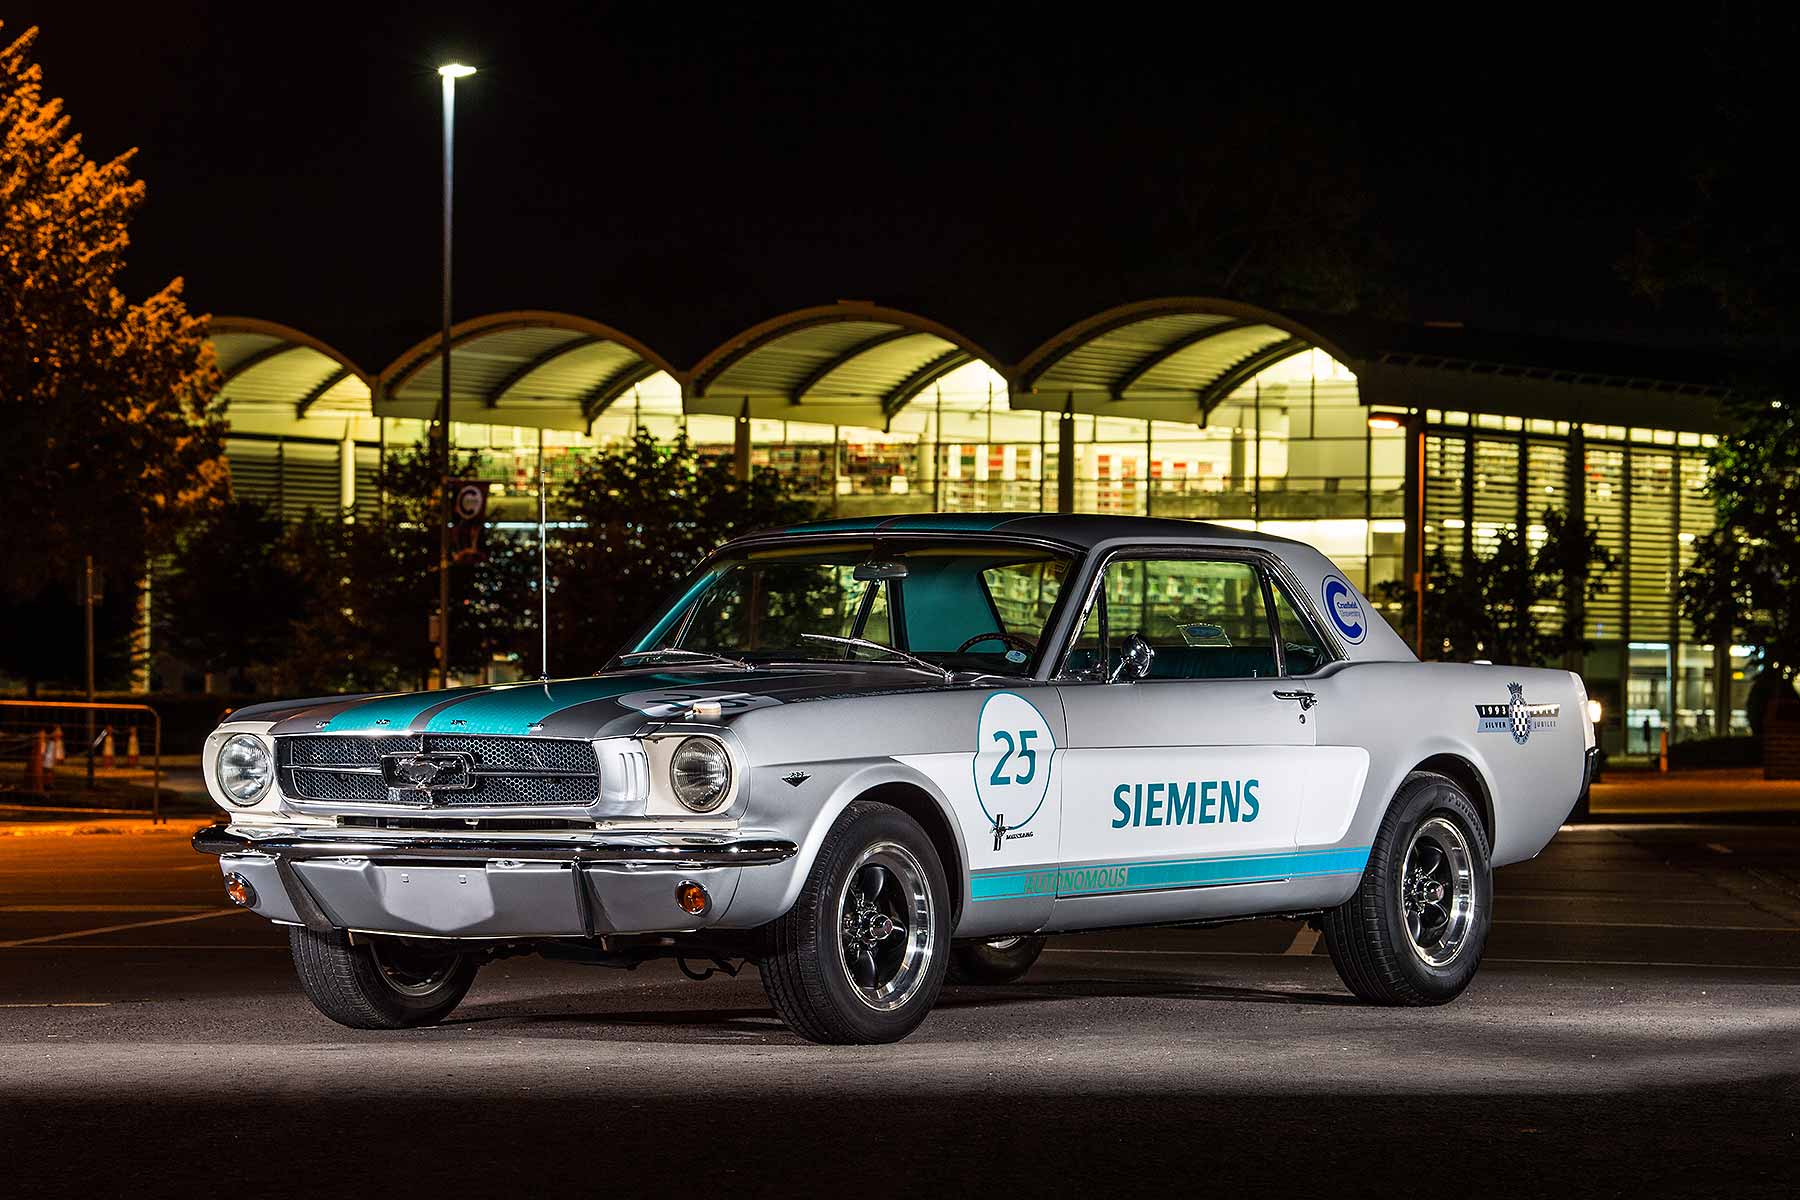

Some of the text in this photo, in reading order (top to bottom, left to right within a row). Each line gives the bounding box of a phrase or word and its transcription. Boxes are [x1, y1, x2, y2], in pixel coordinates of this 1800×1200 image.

[1481, 706, 1506, 715] 1993
[1534, 721, 1556, 729] JUBILEE
[990, 730, 1038, 786] 25
[1111, 779, 1260, 829] SIEMENS
[1006, 831, 1034, 840] MUSTANG
[1024, 867, 1127, 894] AUTONOMOUS
